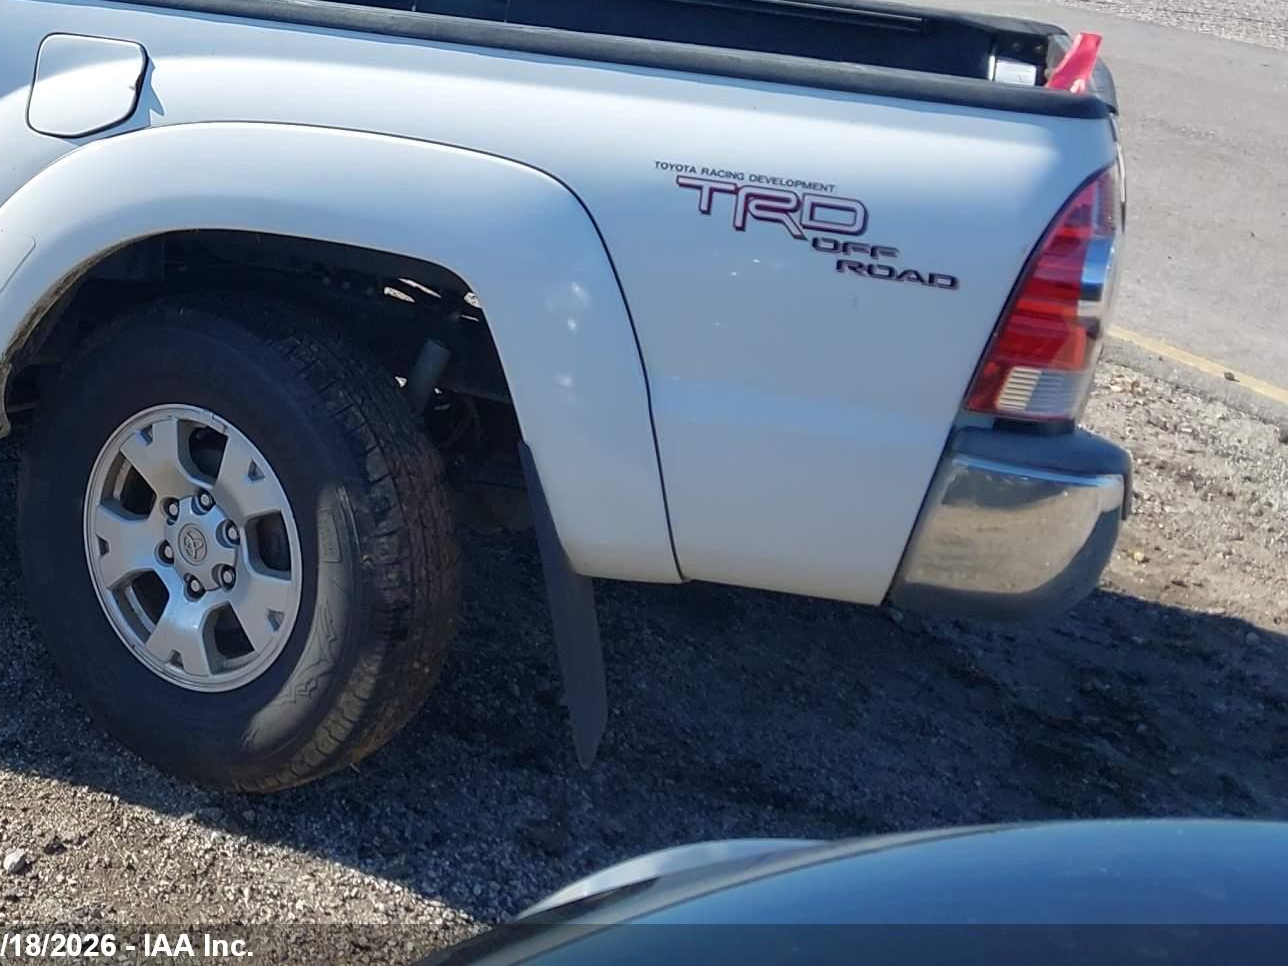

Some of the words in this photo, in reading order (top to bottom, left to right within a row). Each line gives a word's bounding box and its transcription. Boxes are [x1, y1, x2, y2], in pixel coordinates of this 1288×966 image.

[655, 161, 697, 174] TOYOTA
[701, 167, 745, 181] RACING
[749, 174, 835, 193] DEVELOPMENT
[676, 175, 868, 240] TRD
[812, 236, 900, 259] OFF
[836, 259, 960, 290] ROAD
